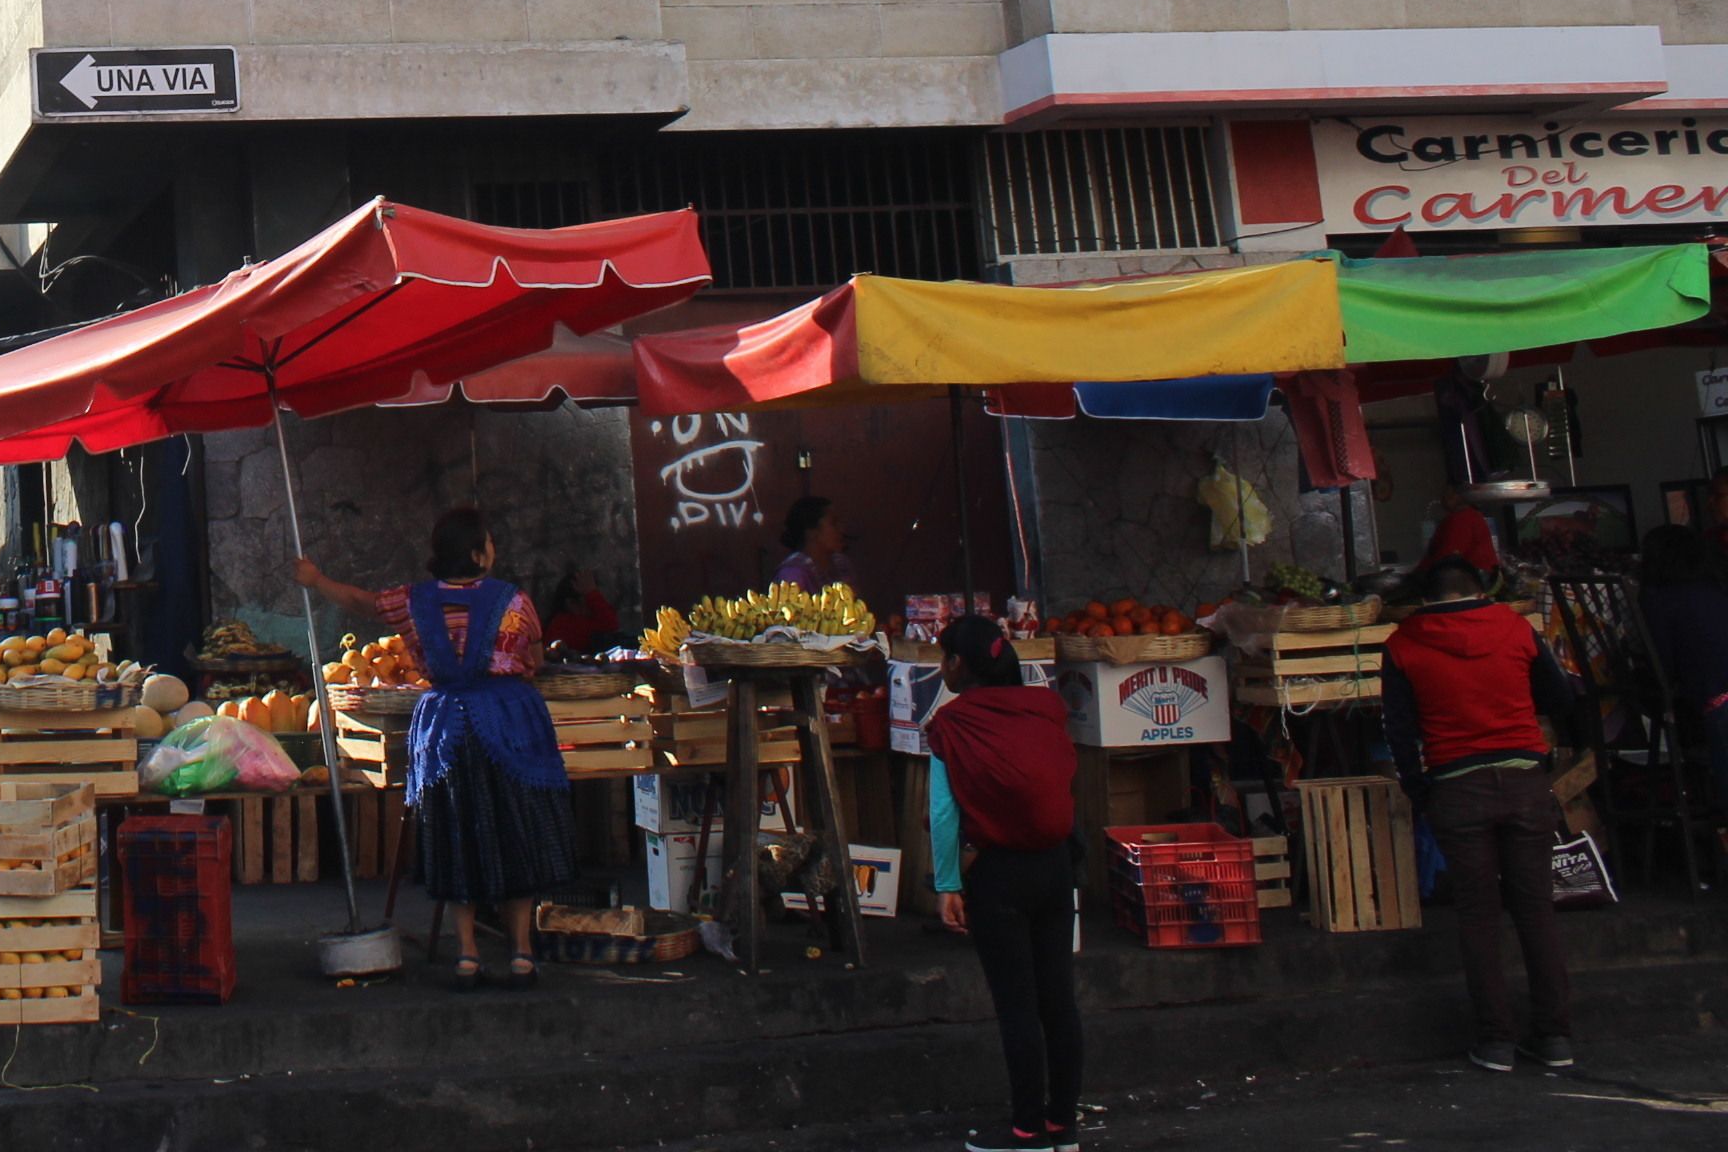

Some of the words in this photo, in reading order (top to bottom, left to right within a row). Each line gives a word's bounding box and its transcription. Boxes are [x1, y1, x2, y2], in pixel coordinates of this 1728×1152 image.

[97, 68, 154, 92] UNA
[162, 67, 208, 91] VIA
[1501, 161, 1590, 188] Del
[1118, 667, 1156, 706] MERIT
[1171, 666, 1209, 702] PRIDE
[1140, 726, 1194, 741] APPLES
[1552, 852, 1589, 870] NITA
